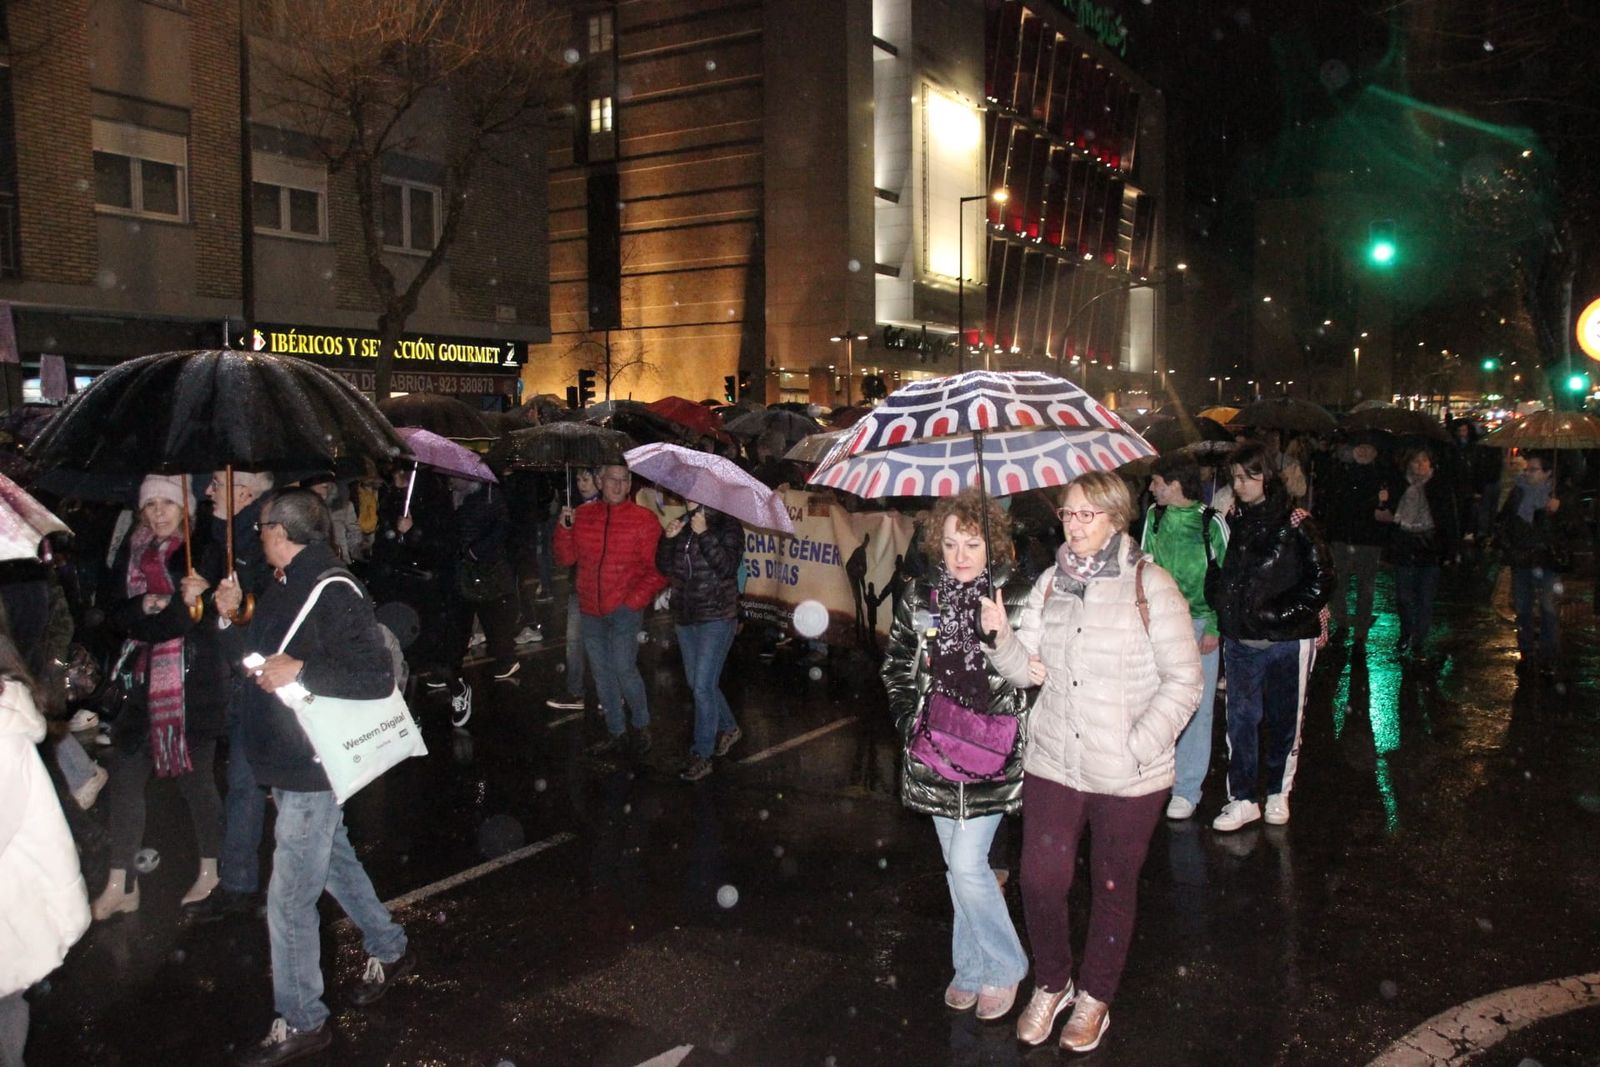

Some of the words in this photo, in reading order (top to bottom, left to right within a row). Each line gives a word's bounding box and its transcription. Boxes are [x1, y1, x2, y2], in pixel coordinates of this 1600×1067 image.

[271, 328, 343, 355] IBÉRICOS
[347, 338, 358, 356] Y
[361, 337, 435, 360] SECCIÓN
[439, 343, 500, 364] GOURMET
[744, 533, 776, 553] CHA
[789, 535, 841, 566] GÉNER
[342, 727, 380, 750] Western
[380, 712, 406, 732] Digital
